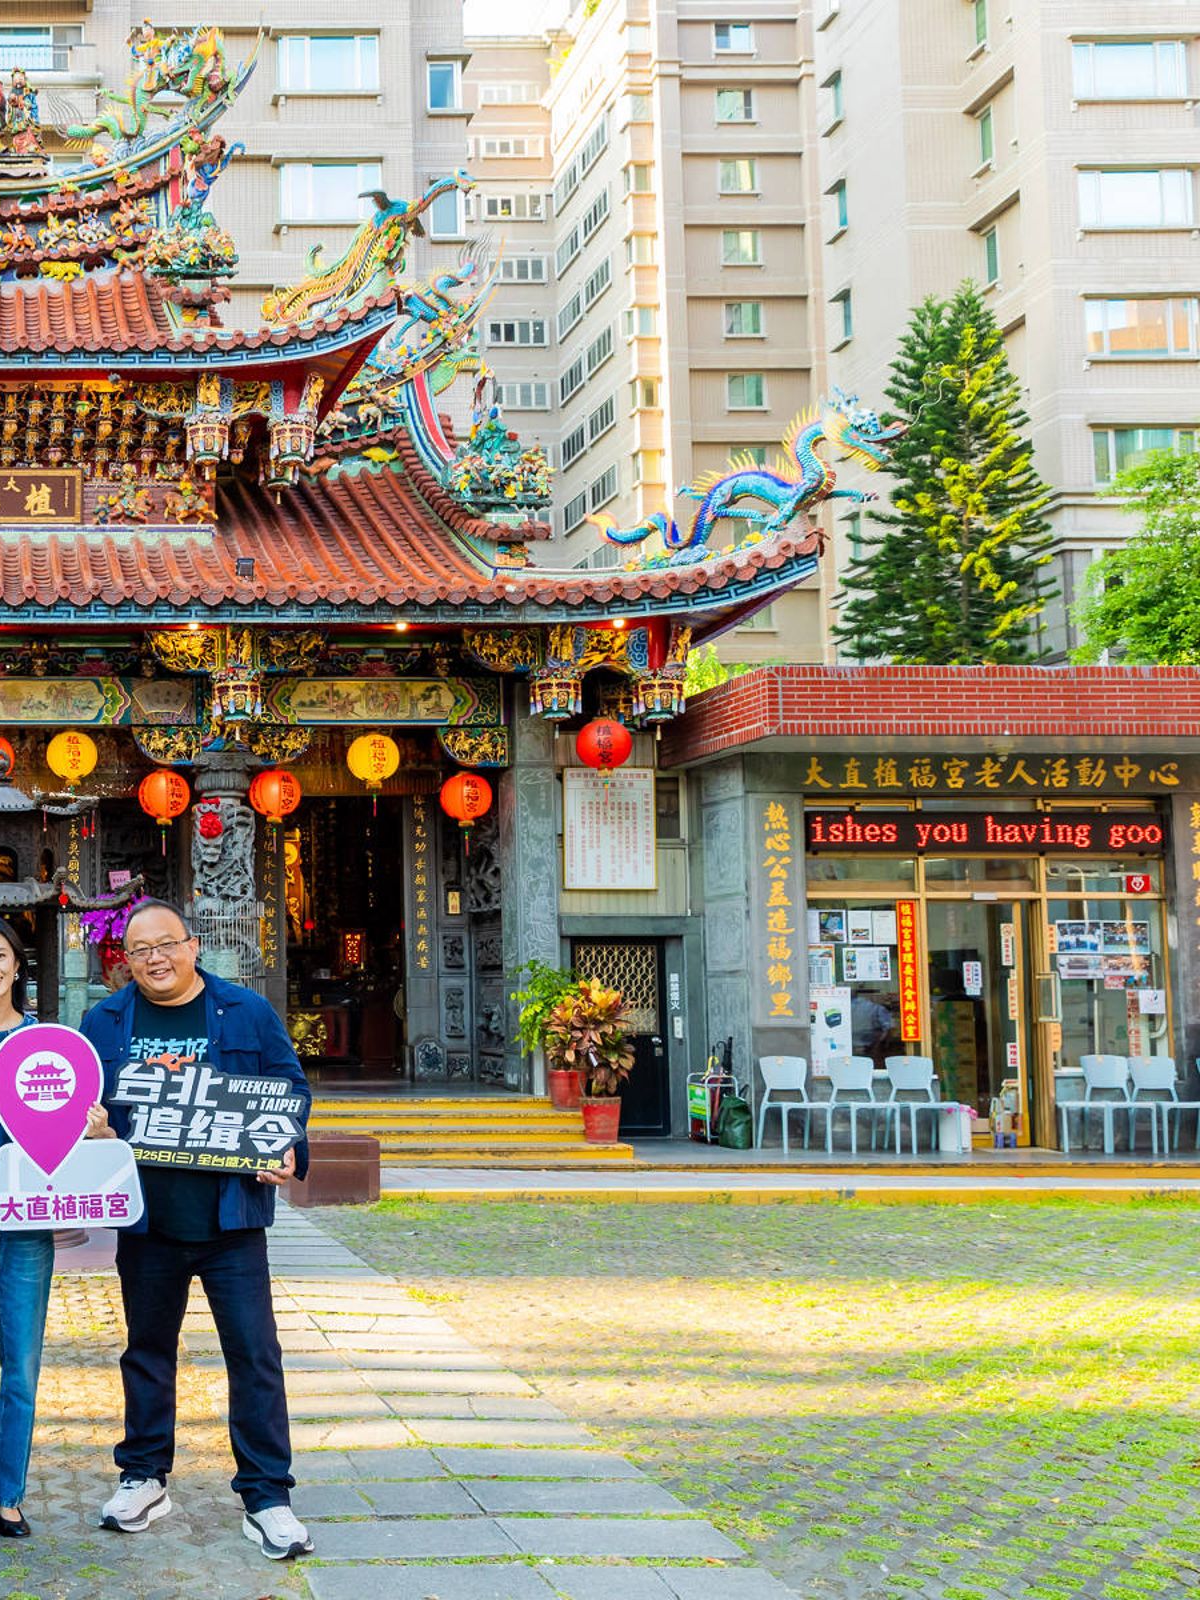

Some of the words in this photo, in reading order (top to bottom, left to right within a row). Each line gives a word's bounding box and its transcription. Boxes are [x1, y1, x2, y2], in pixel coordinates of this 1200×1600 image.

[66, 736, 81, 770] 植福宮
[370, 739, 386, 774] 植福宮
[803, 756, 1181, 789] 大直植福宮老人活動中心
[169, 777, 184, 811] 植福宮
[281, 775, 295, 810] 植福宮
[464, 779, 481, 812] 植福宮
[810, 816, 897, 843] ishes
[915, 823, 968, 848] you
[985, 816, 1092, 848] having
[1108, 823, 1163, 848] goo
[763, 801, 795, 1017] 熱心公益造福鄉里
[900, 903, 918, 1038] 植福宮管理委員會辦公室
[130, 1037, 208, 1061] 台法友好
[109, 1062, 223, 1107] 台北
[227, 1079, 288, 1096] WEEKEND
[259, 1097, 301, 1113] TAIPEI
[128, 1104, 299, 1154] 追緝令
[132, 1150, 194, 1164] 月25日(三)
[197, 1154, 282, 1170] 全台盛大上映
[0, 1192, 129, 1222] 大直植福宮
